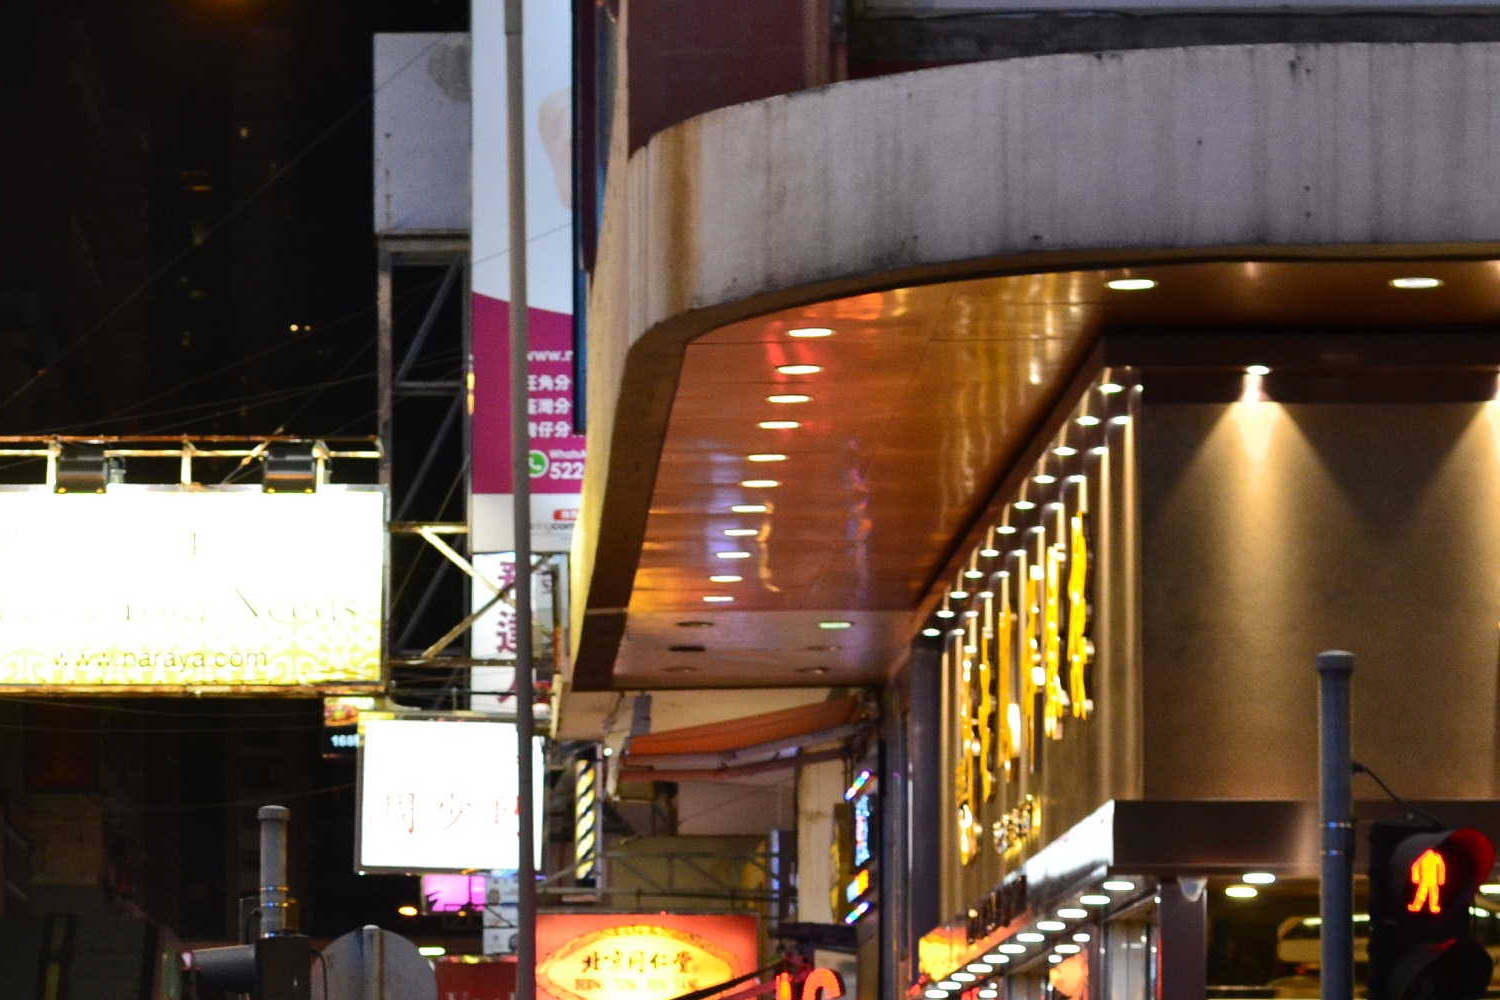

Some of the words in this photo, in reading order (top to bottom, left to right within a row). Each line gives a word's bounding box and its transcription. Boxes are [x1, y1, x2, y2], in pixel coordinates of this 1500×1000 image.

[52, 650, 268, 673] www.naraya.com
[581, 950, 693, 973] 北京同仁堂
